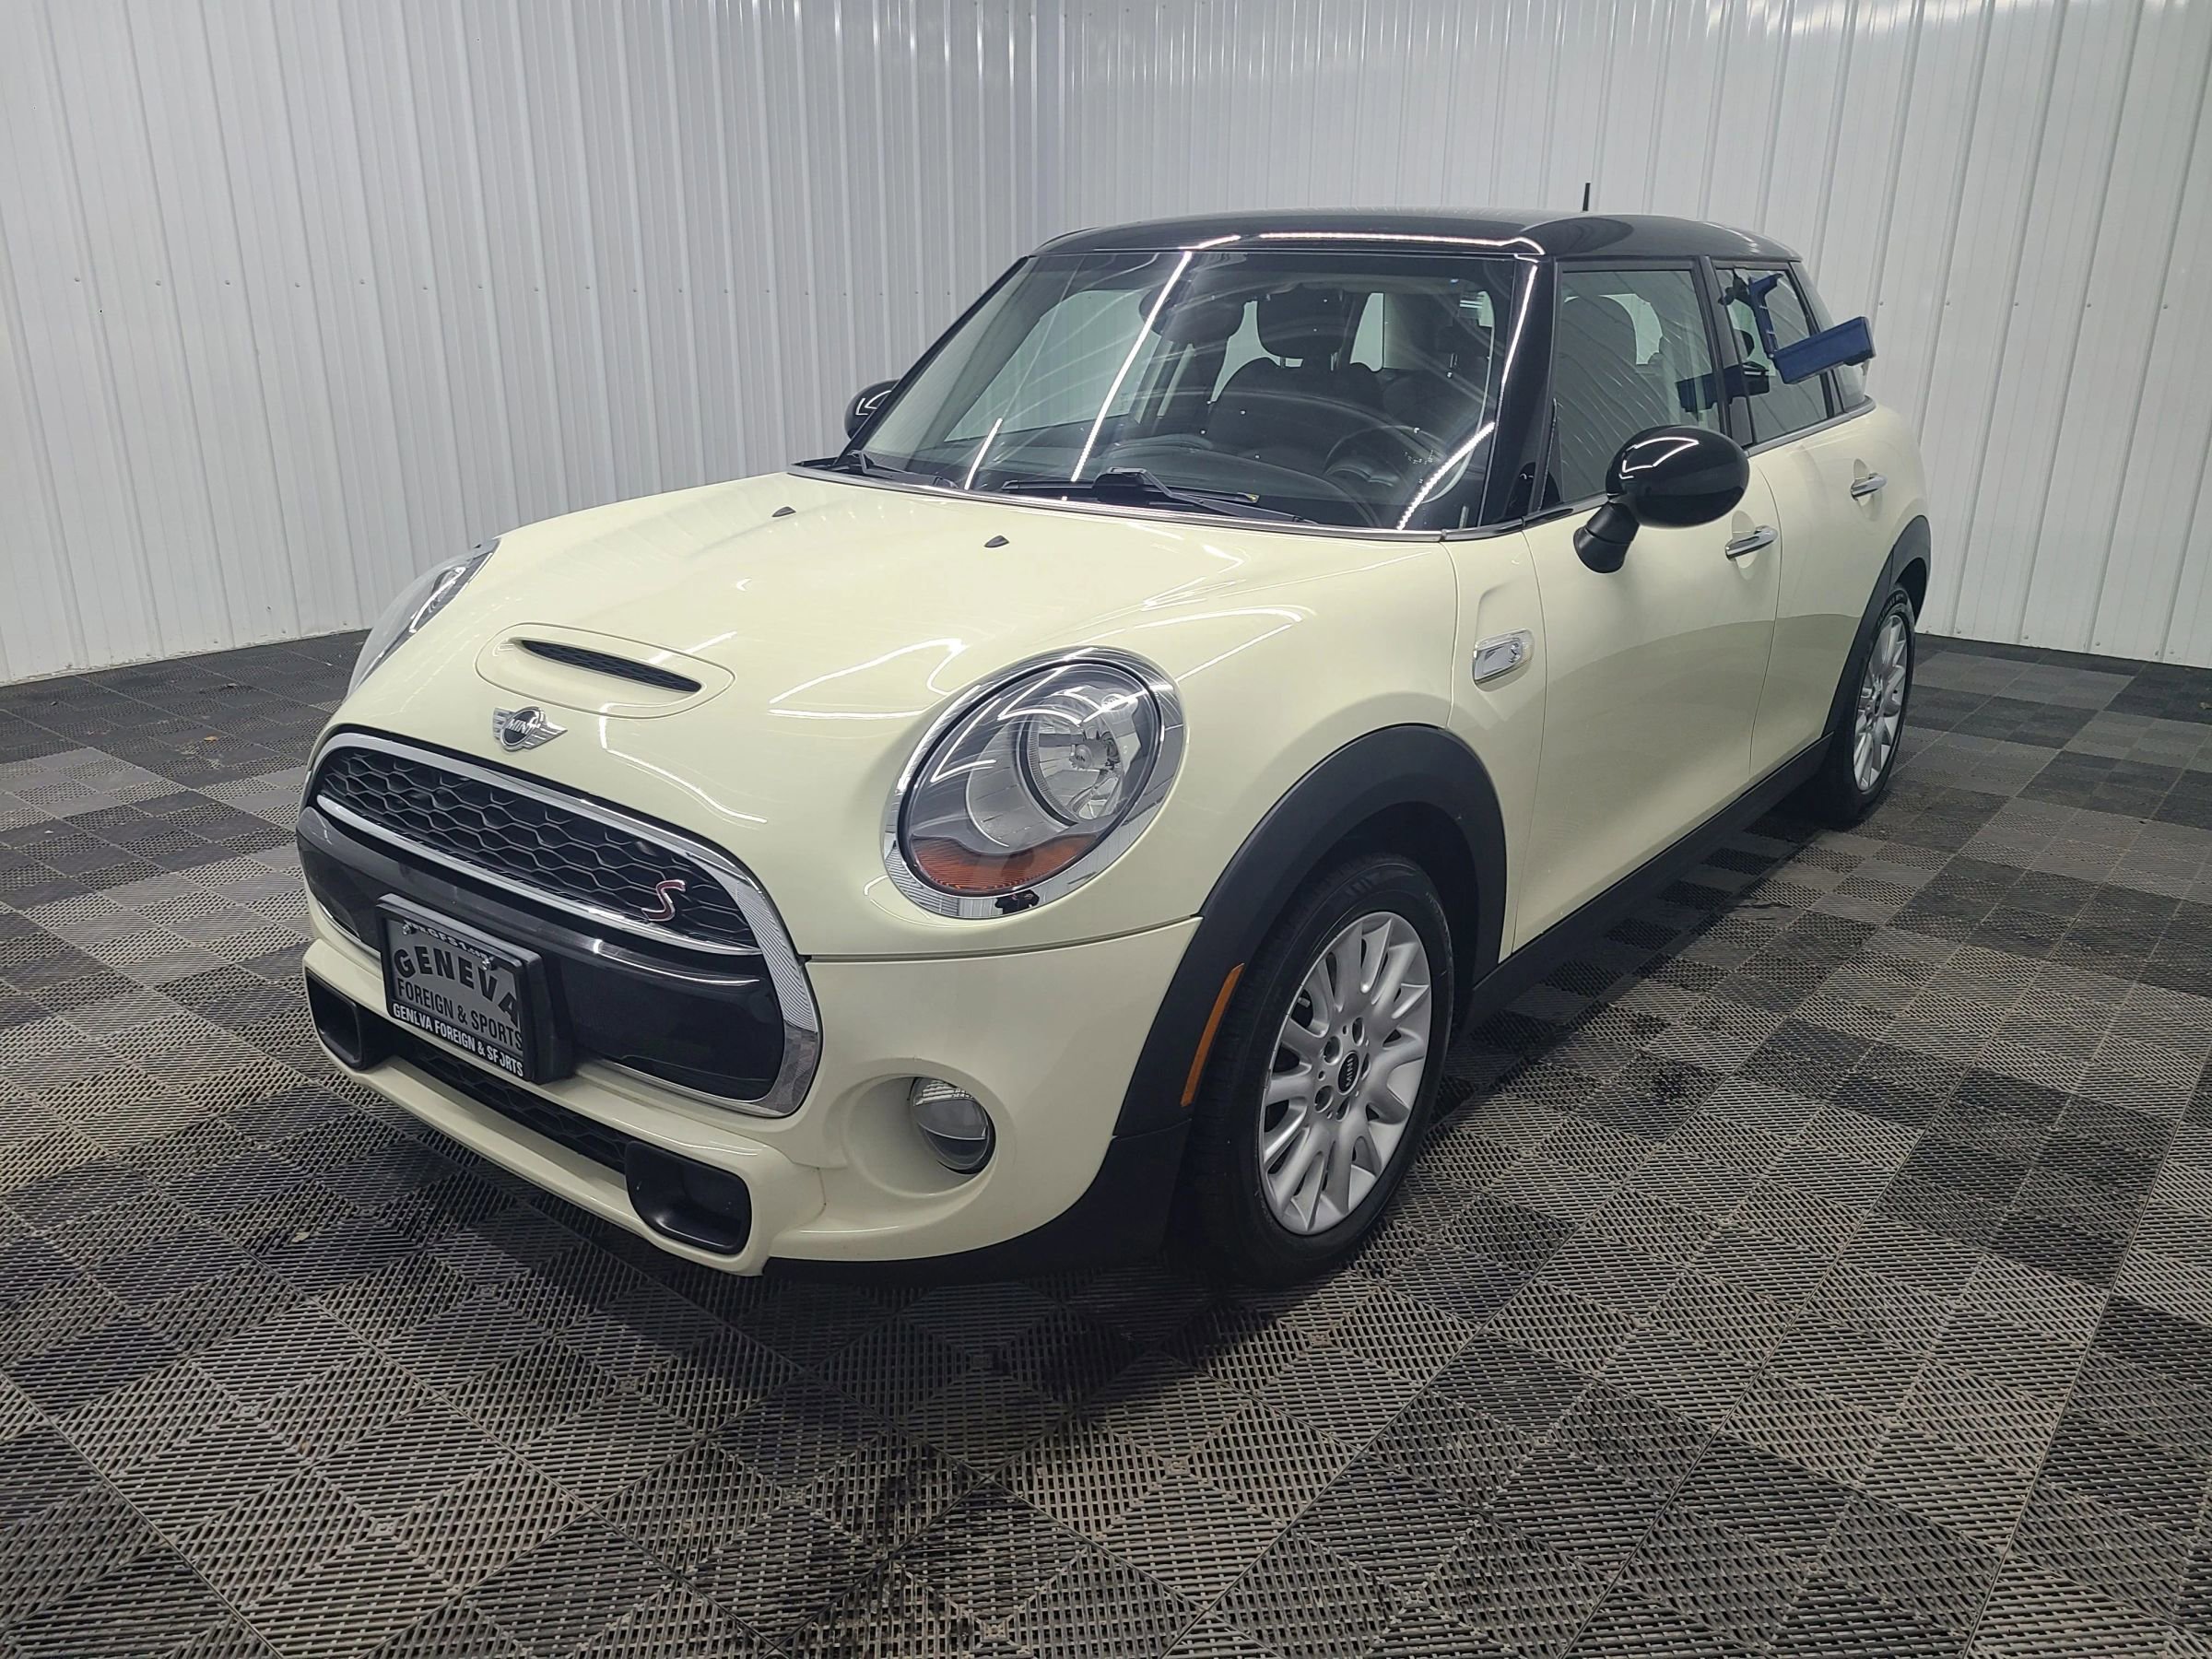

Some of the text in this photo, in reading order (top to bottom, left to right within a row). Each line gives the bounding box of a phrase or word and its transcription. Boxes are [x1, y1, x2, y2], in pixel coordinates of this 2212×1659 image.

[641, 879, 686, 922] S
[394, 946, 519, 1029] GENEVA
[397, 977, 523, 1049] FOREIGN & SPORTS
[434, 1019, 476, 1053] FOREIGN
[477, 1041, 486, 1057] &
